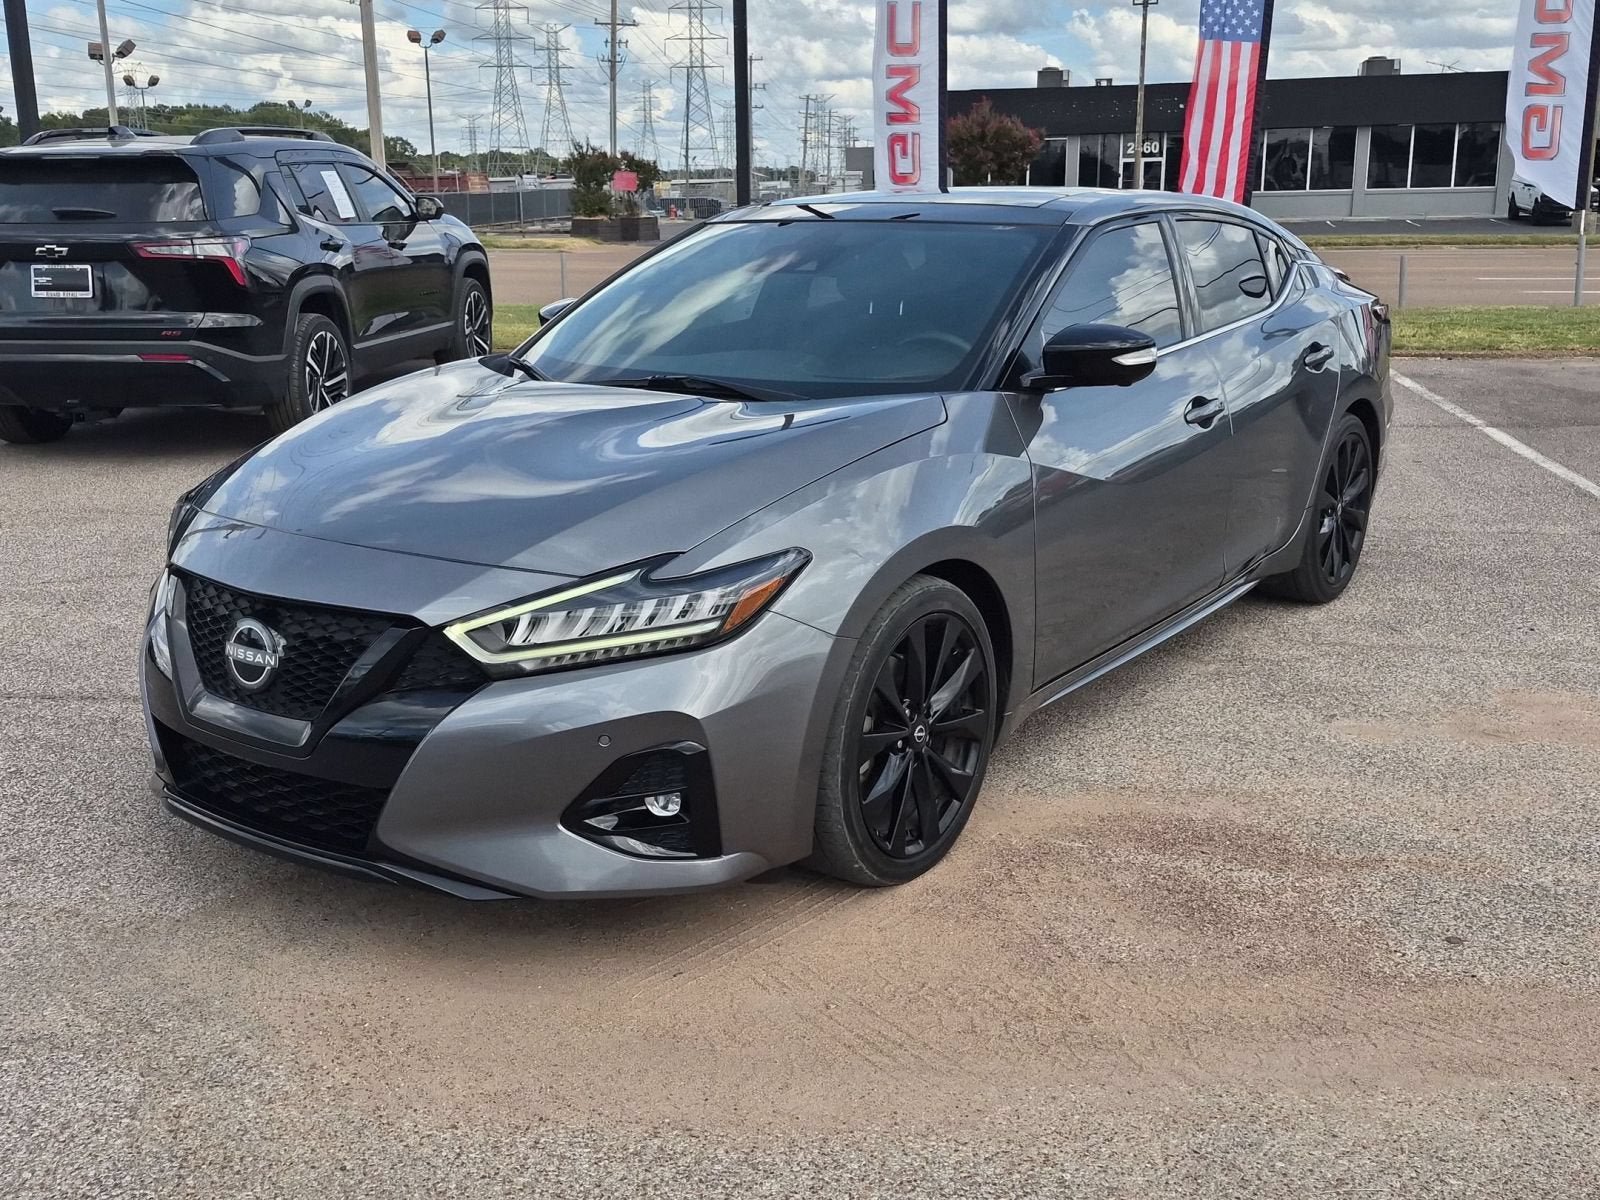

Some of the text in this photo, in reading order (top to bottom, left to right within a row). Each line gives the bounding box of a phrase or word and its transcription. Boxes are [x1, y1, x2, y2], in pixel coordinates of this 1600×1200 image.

[886, 1, 921, 186] GMC
[1126, 141, 1160, 154] 260
[226, 643, 276, 666] NISSAN
